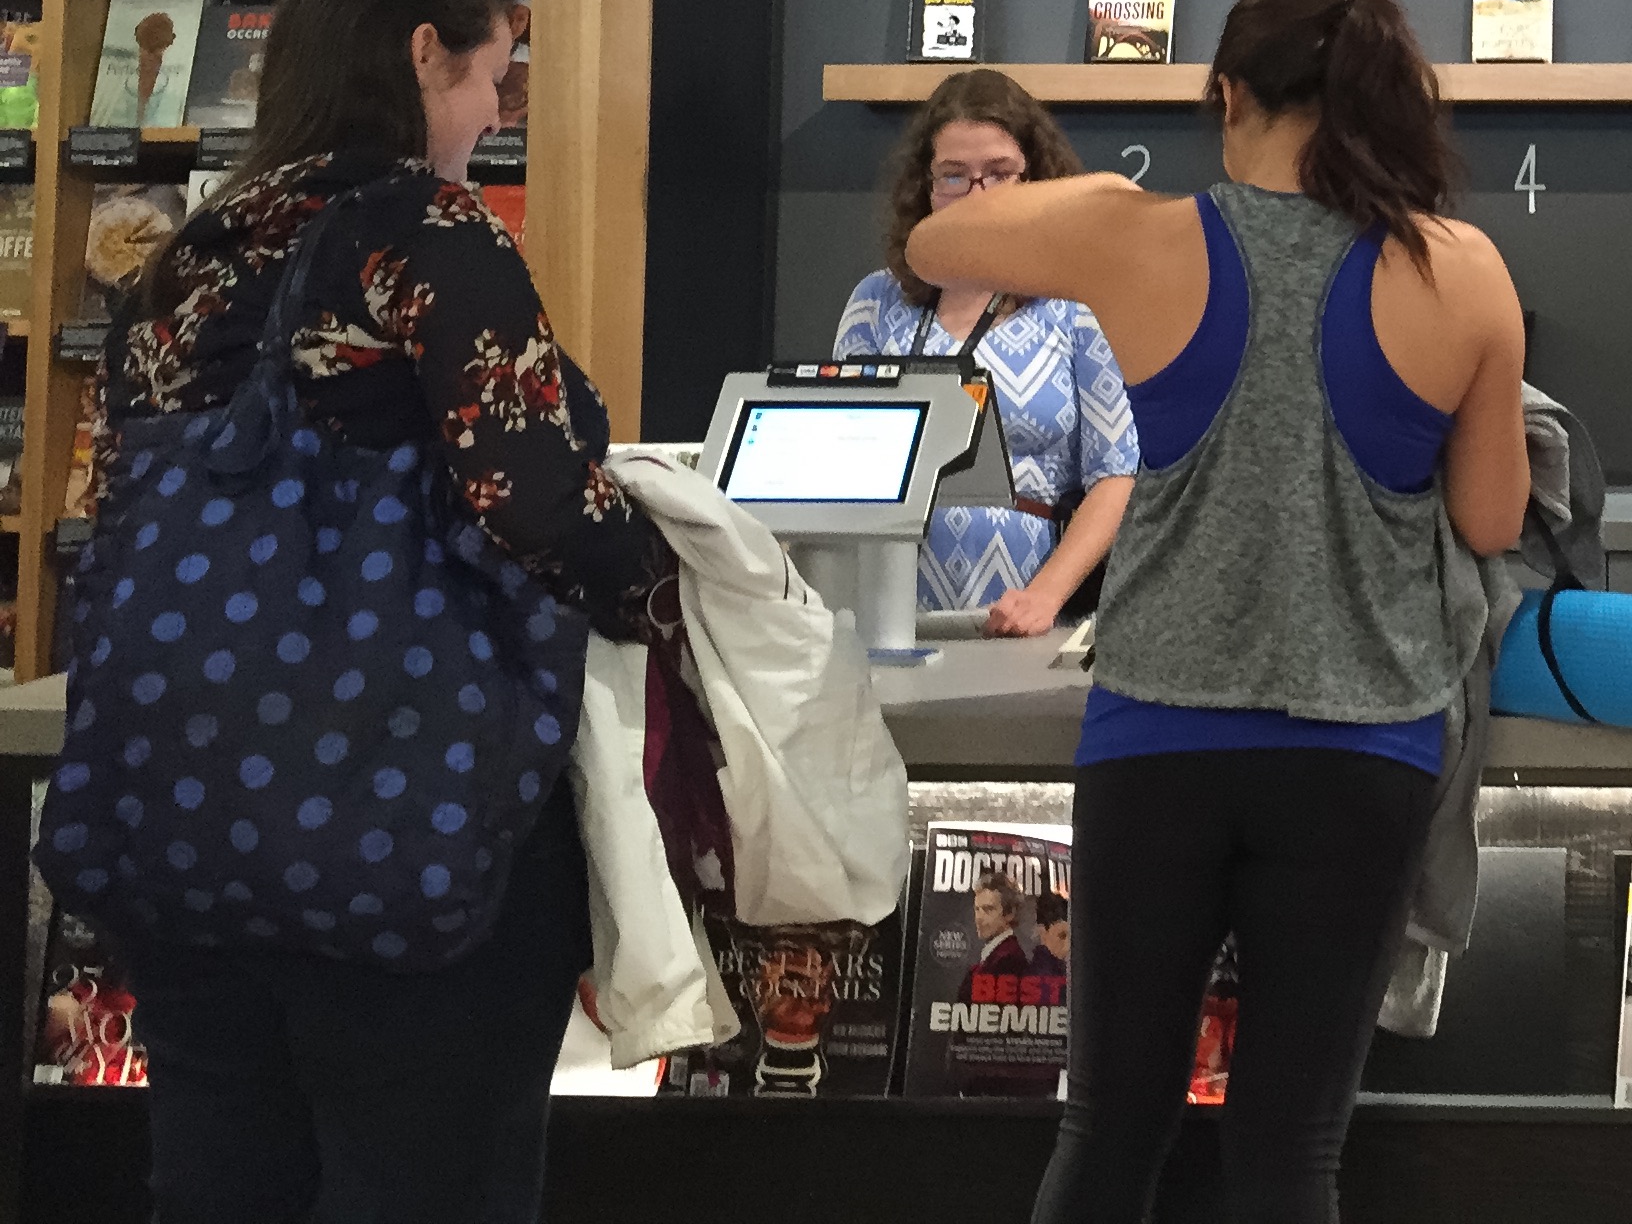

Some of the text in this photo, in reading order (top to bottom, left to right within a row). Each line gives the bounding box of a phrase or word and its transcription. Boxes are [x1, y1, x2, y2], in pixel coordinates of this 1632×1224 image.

[1093, 1, 1165, 20] CROSSING
[1121, 144, 1151, 182] 2
[1514, 143, 1546, 214] 4
[932, 849, 1042, 896] DOCTOR
[717, 948, 884, 980] BEST BARS
[738, 978, 882, 1002] COCKTAILS
[971, 973, 1067, 1006] BEST
[929, 1001, 1069, 1036] ENEMIE
